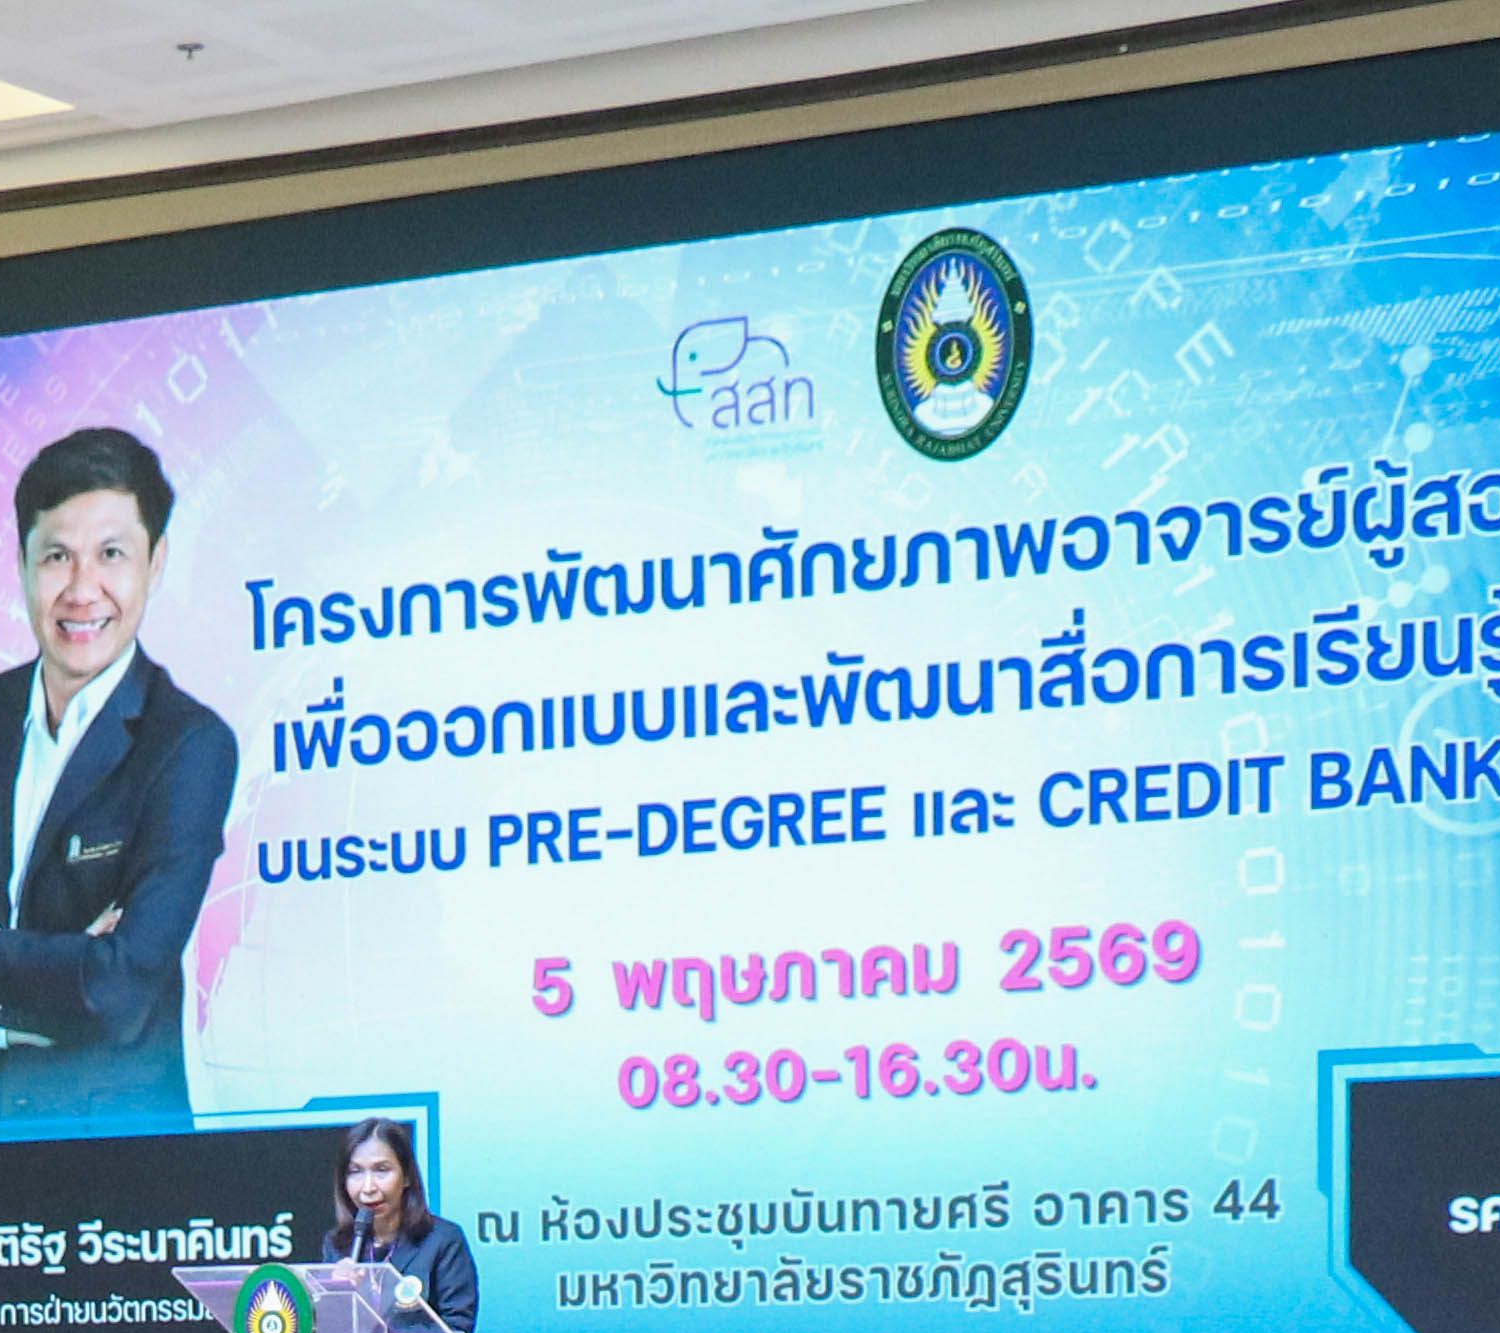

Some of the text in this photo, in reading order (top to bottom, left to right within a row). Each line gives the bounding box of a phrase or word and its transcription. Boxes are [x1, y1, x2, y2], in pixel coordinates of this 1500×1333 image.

[711, 374, 814, 430] สสท
[256, 827, 466, 883] บนระบบ
[488, 785, 887, 867] PRE-DEGREE
[912, 786, 1015, 837] และ
[1038, 755, 1286, 828] CREDIT
[530, 918, 1202, 1023] 5 พฤษภาคม 2569
[617, 1035, 1098, 1110] 08.30-16.30น.
[77, 1211, 295, 1265] วีระนาคินทร์
[475, 1177, 1281, 1250] ณ ห้องประชุมบันทายศรี อาคาร 44
[556, 1244, 1173, 1313] มหาวิทยาลัยราชภัฏสุรินทร์
